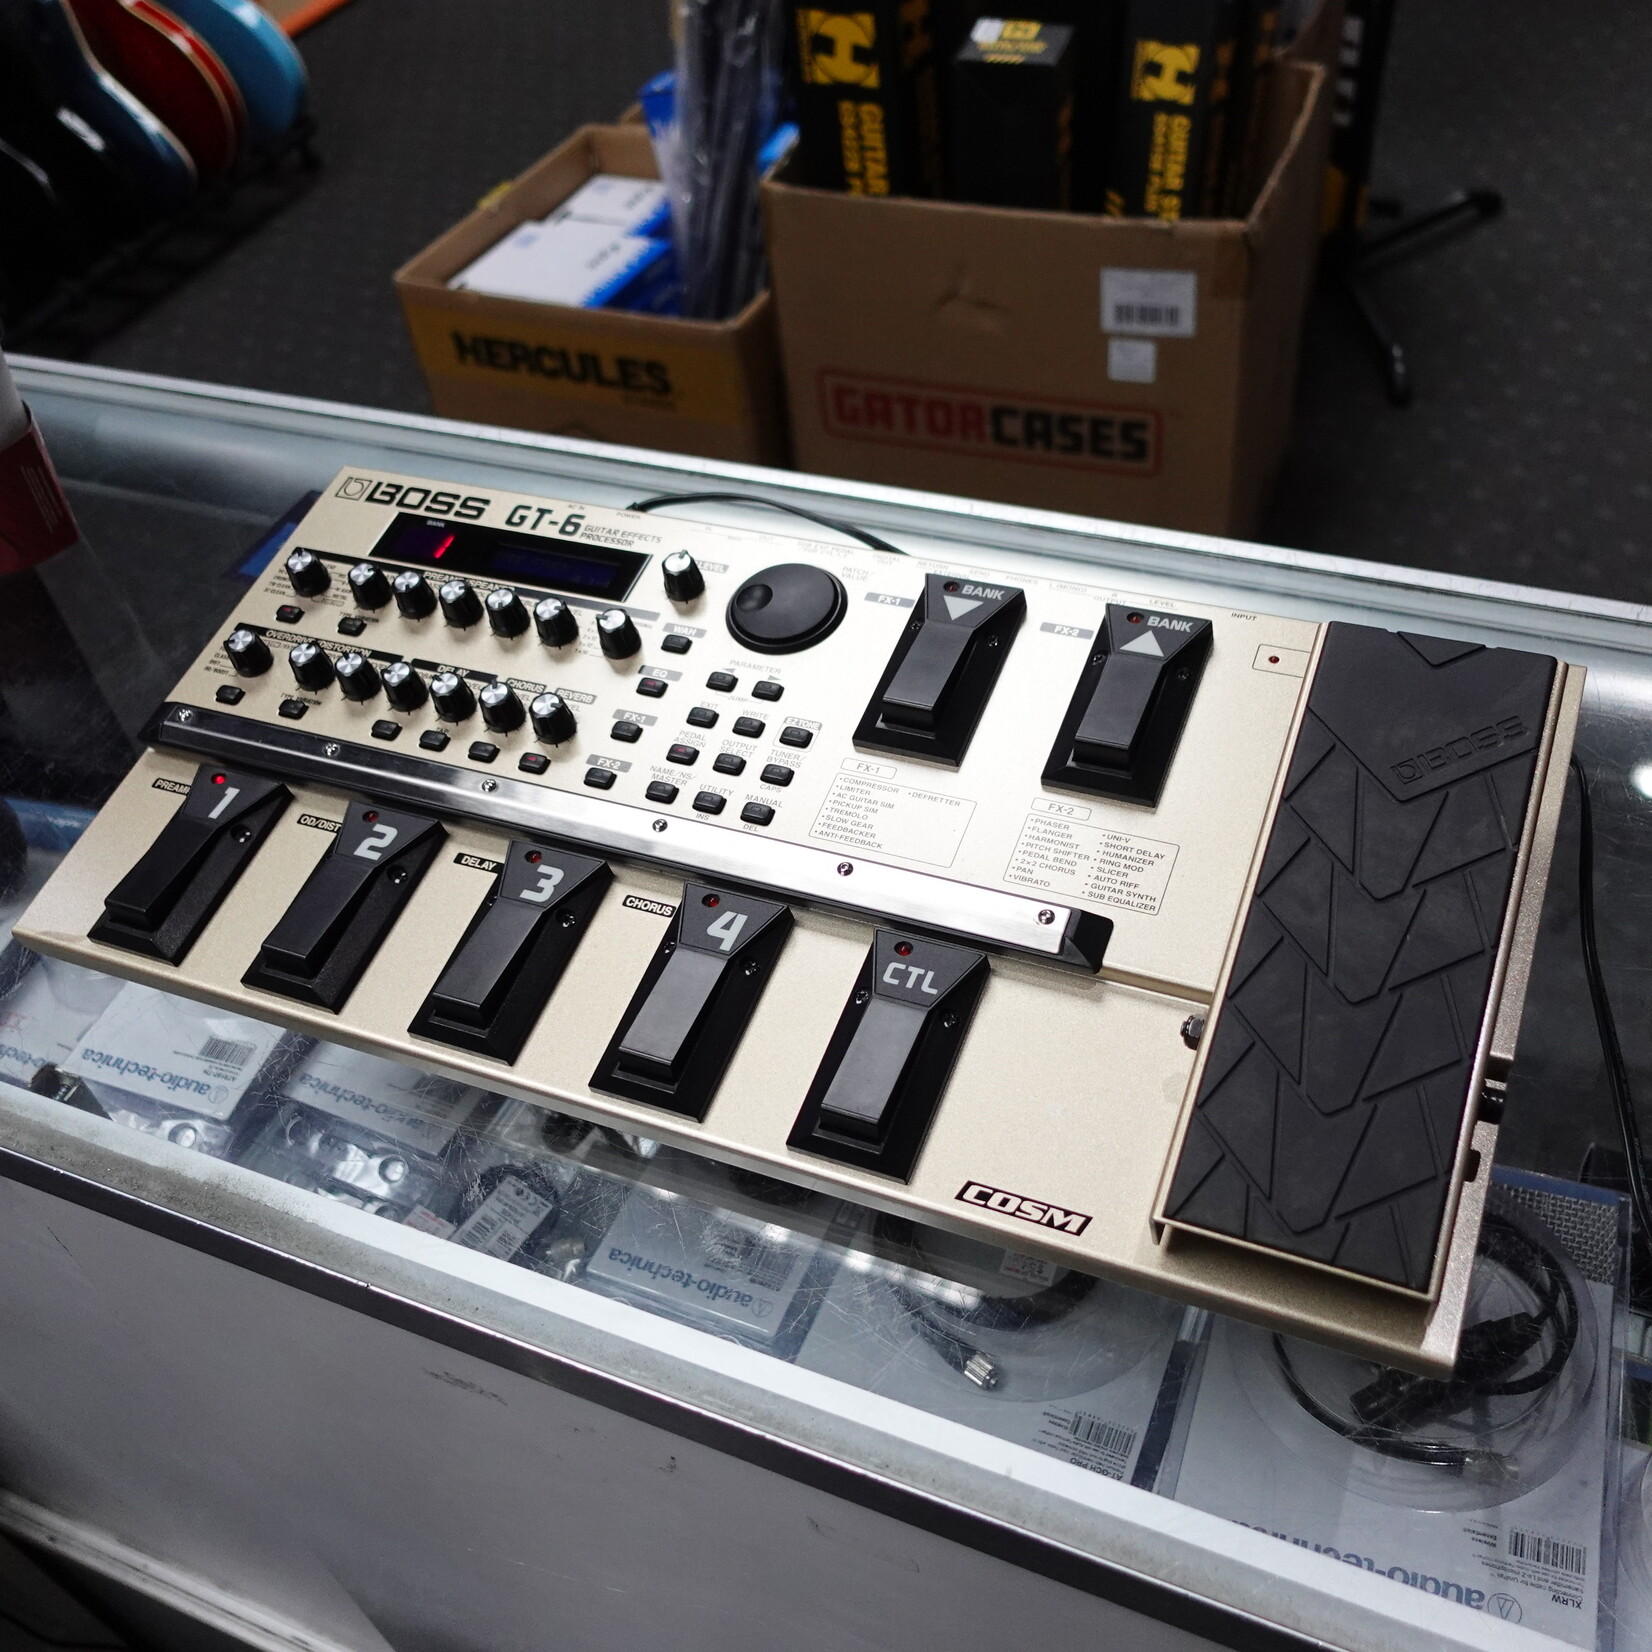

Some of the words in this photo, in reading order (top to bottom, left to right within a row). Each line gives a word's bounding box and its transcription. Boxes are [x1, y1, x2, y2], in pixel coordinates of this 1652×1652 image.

[453, 330, 671, 395] HERCULES
[364, 481, 491, 521] BOSS
[505, 504, 587, 536] GT-6
[579, 532, 636, 547] PROCESSOR
[584, 524, 621, 537] GUITAR
[621, 530, 663, 544] EFFECTS
[877, 594, 902, 607] FX-1
[962, 584, 1006, 602] BANK
[1149, 598, 1176, 608] LEVEL
[1147, 615, 1193, 633] BANK
[1230, 611, 1258, 622] INPUT
[673, 624, 698, 637] WAH
[1053, 625, 1080, 638] FX-2
[651, 668, 668, 679] EQ
[729, 658, 782, 675] PARAMETER
[507, 679, 545, 693] CHORUS
[557, 689, 595, 703] REVERB
[727, 694, 750, 704] JUMP
[700, 701, 719, 710] EXIT
[623, 711, 647, 723] FX-1
[741, 709, 770, 721] WRITE
[797, 720, 822, 731] TONE
[673, 736, 707, 749] ASSIGN
[679, 730, 707, 742] PEDAL
[719, 745, 754, 758] SELECT
[722, 739, 758, 752] OUTPUT
[1417, 714, 1530, 775] BOSS
[596, 757, 622, 770] FX-2
[766, 756, 803, 769] BYPASS
[770, 749, 807, 762] TUNER/
[650, 764, 697, 781] NAME/NS/
[856, 762, 881, 775] FX-1
[155, 779, 190, 795] PREAM
[651, 772, 689, 787] MASTER
[843, 776, 900, 794] COMPRESSOR
[699, 783, 735, 797] UTILITY
[759, 783, 783, 794] CAPS
[839, 785, 872, 796] LIMITER
[207, 787, 240, 819] 1
[745, 793, 784, 809] MANUAL
[832, 799, 863, 811] PICKUP
[863, 805, 879, 815] SIM
[835, 792, 847, 801] AC
[848, 794, 879, 807] GUITAR
[879, 800, 895, 810] SIM
[911, 791, 962, 808] DEFRETTER
[695, 813, 711, 821] INS
[829, 806, 869, 821] TREMOLO
[1047, 803, 1075, 816] FX-2
[300, 816, 341, 832] OD/DIST
[742, 823, 760, 833] DEL
[821, 821, 877, 840] FEEDBACKER
[825, 814, 849, 825] SLOW
[850, 819, 874, 831] GEAR
[1034, 818, 1070, 831] PHASER
[817, 829, 884, 850] ANTI-FEEDBACK
[1031, 826, 1073, 840] FLANGER
[1106, 833, 1132, 844] UNI-V
[353, 824, 399, 861] 2
[1027, 834, 1080, 850] HARMONIST
[1022, 849, 1052, 862] PEDAL
[1052, 856, 1078, 868] BEND
[1025, 841, 1052, 853] PITCH
[1052, 847, 1090, 862] SHIFTER
[1102, 849, 1156, 867] HUMANIZER
[1103, 841, 1136, 853] SHORT
[1136, 848, 1166, 861] DELAY
[460, 856, 497, 872] DELAY
[1015, 865, 1035, 876] PAN
[1038, 862, 1077, 876] CHORUS
[1099, 858, 1122, 869] RING
[1122, 863, 1145, 874] MOD
[1012, 873, 1052, 888] VIBRATO
[1096, 866, 1129, 879] SLICER
[520, 865, 566, 902] 3
[1093, 874, 1119, 886] AUTO
[1119, 879, 1141, 890] RIFF
[1090, 882, 1125, 896] GUITAR
[1125, 889, 1158, 903] SYNTH
[624, 896, 675, 916] CHORUS
[1087, 890, 1107, 902] SUB
[1107, 895, 1157, 913] EQUALIZER
[706, 911, 749, 951] 4
[881, 961, 939, 995] CTL
[80, 1047, 211, 1096] audio-technica
[960, 1182, 1088, 1235] COSM
[607, 1246, 754, 1308] audio-technica
[1551, 1594, 1582, 1610] XLRW
